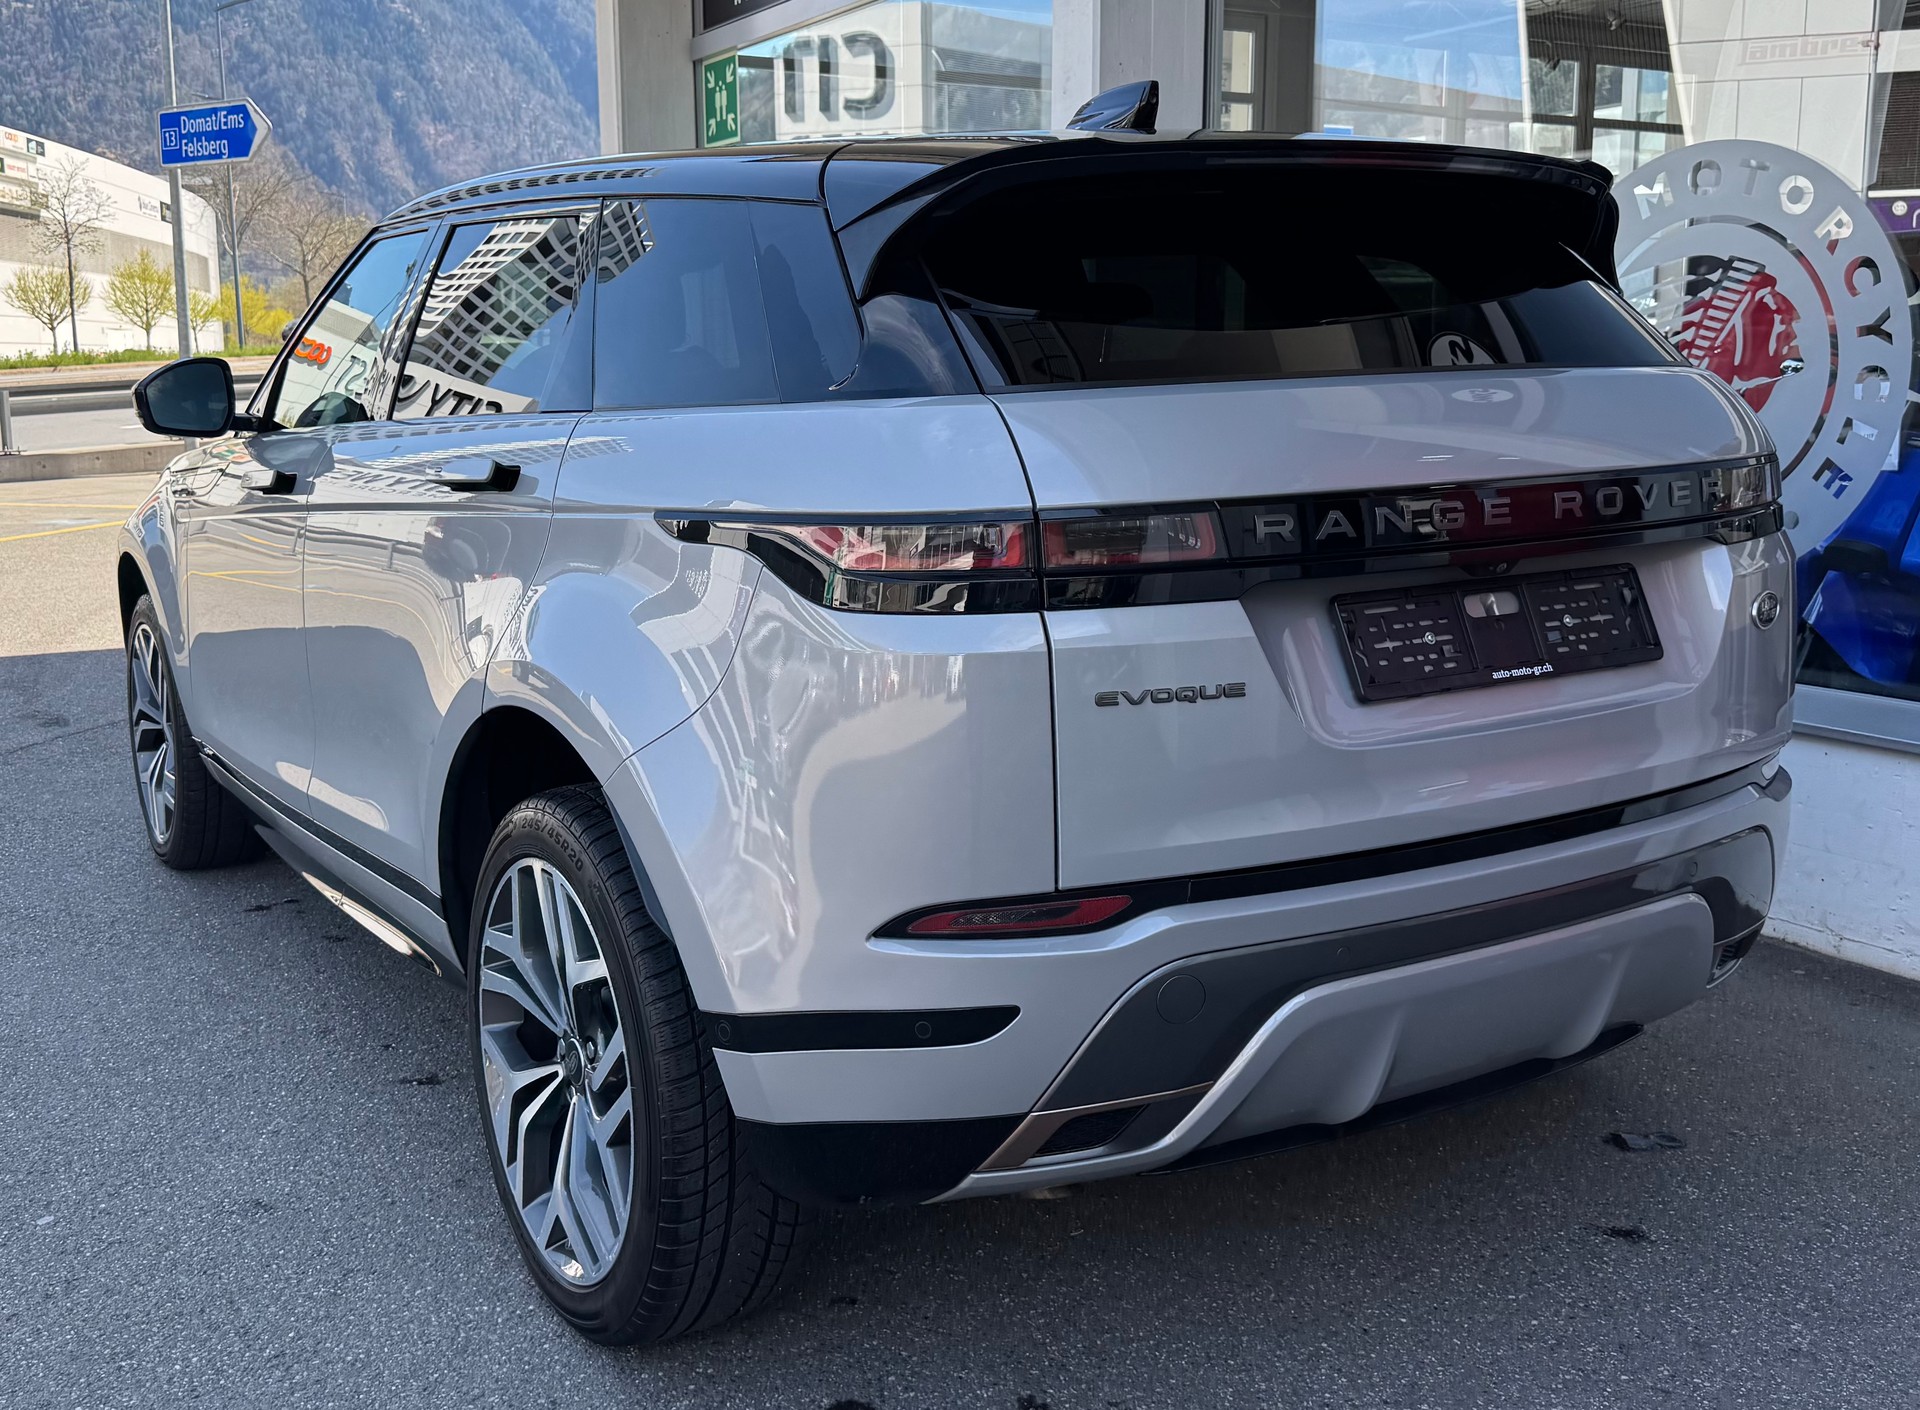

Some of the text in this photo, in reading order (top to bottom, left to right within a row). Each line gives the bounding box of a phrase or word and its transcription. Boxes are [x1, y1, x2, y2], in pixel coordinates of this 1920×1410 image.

[180, 111, 245, 134] Domat/Ems
[164, 131, 176, 146] 13
[181, 136, 229, 158] Felsberg
[1633, 158, 1893, 499] MOTORCYCLE
[1254, 474, 1723, 544] RANGE ROVER
[1492, 662, 1554, 679] auto-moto-gr.ch
[1094, 682, 1247, 707] EVOQUE
[521, 817, 585, 872] 245/45R20
